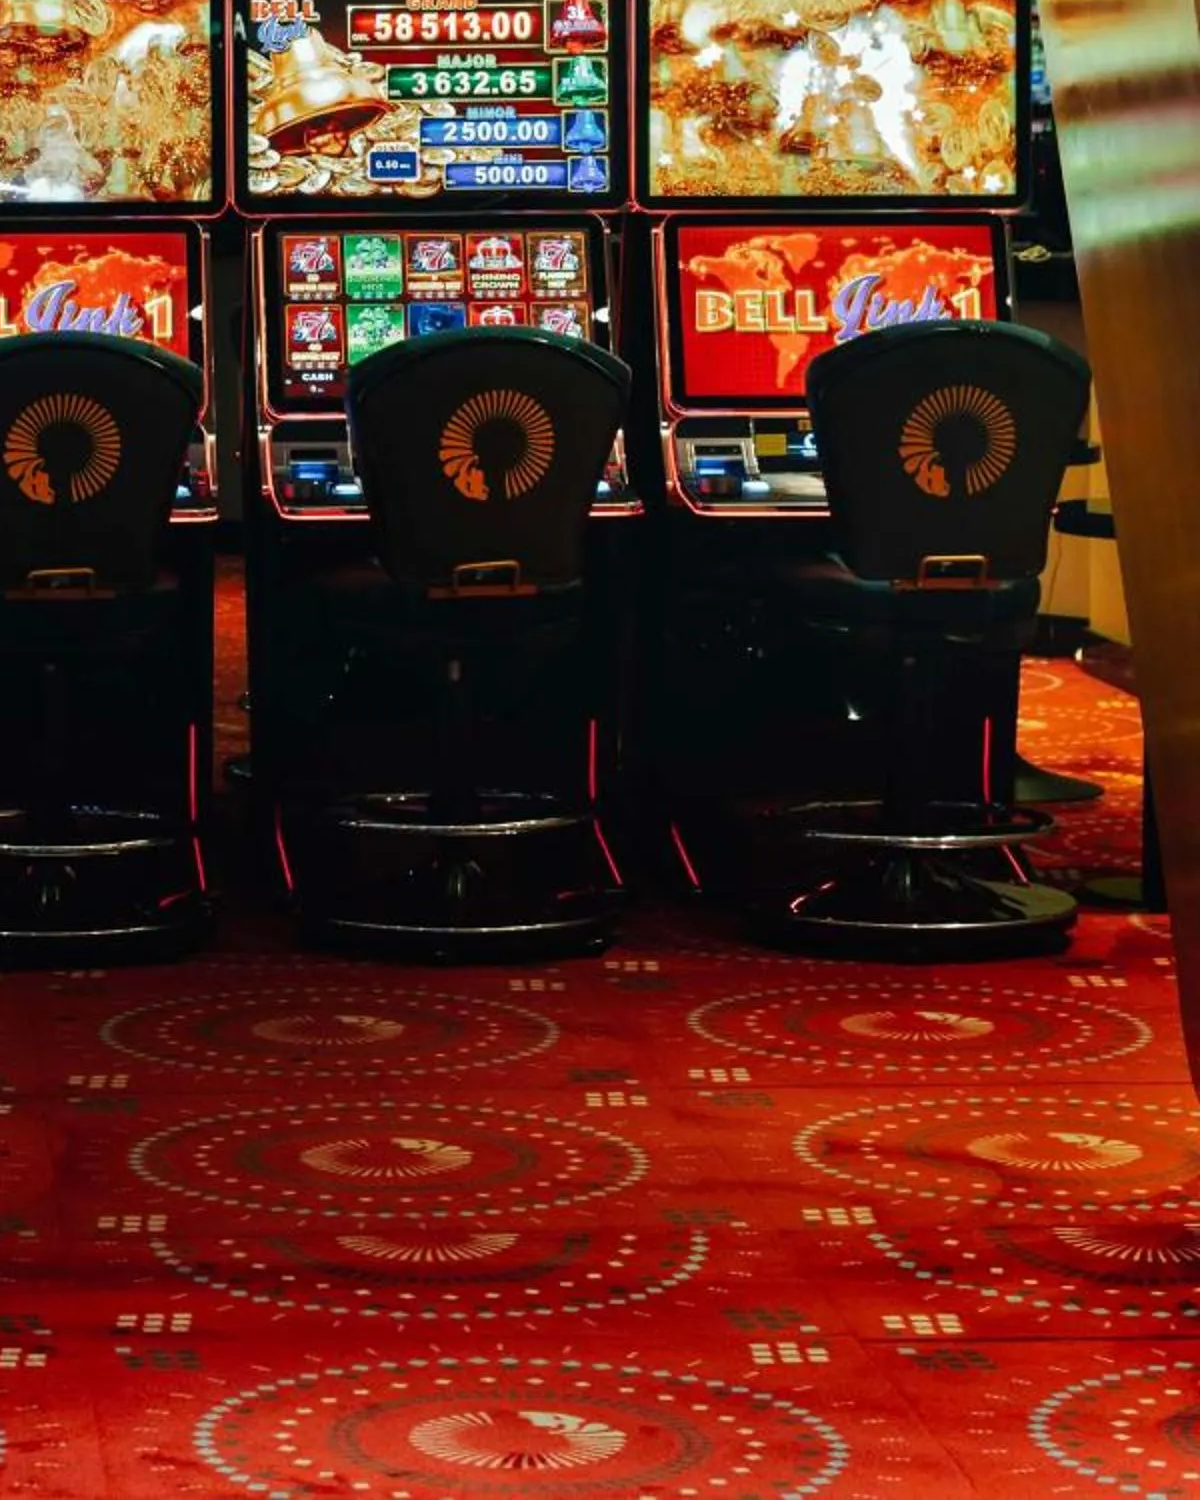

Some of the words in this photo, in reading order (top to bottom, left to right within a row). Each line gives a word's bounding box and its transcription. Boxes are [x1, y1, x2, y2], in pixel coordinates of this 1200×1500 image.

[437, 54, 497, 70] MAJOR
[466, 106, 516, 120] MINOR
[474, 165, 548, 184] 500.00
[23, 279, 144, 335] Link
[143, 295, 174, 341] 1
[694, 287, 829, 333] BELL
[831, 273, 952, 344] Link
[949, 287, 982, 321] 1
[301, 373, 335, 383] CASH
